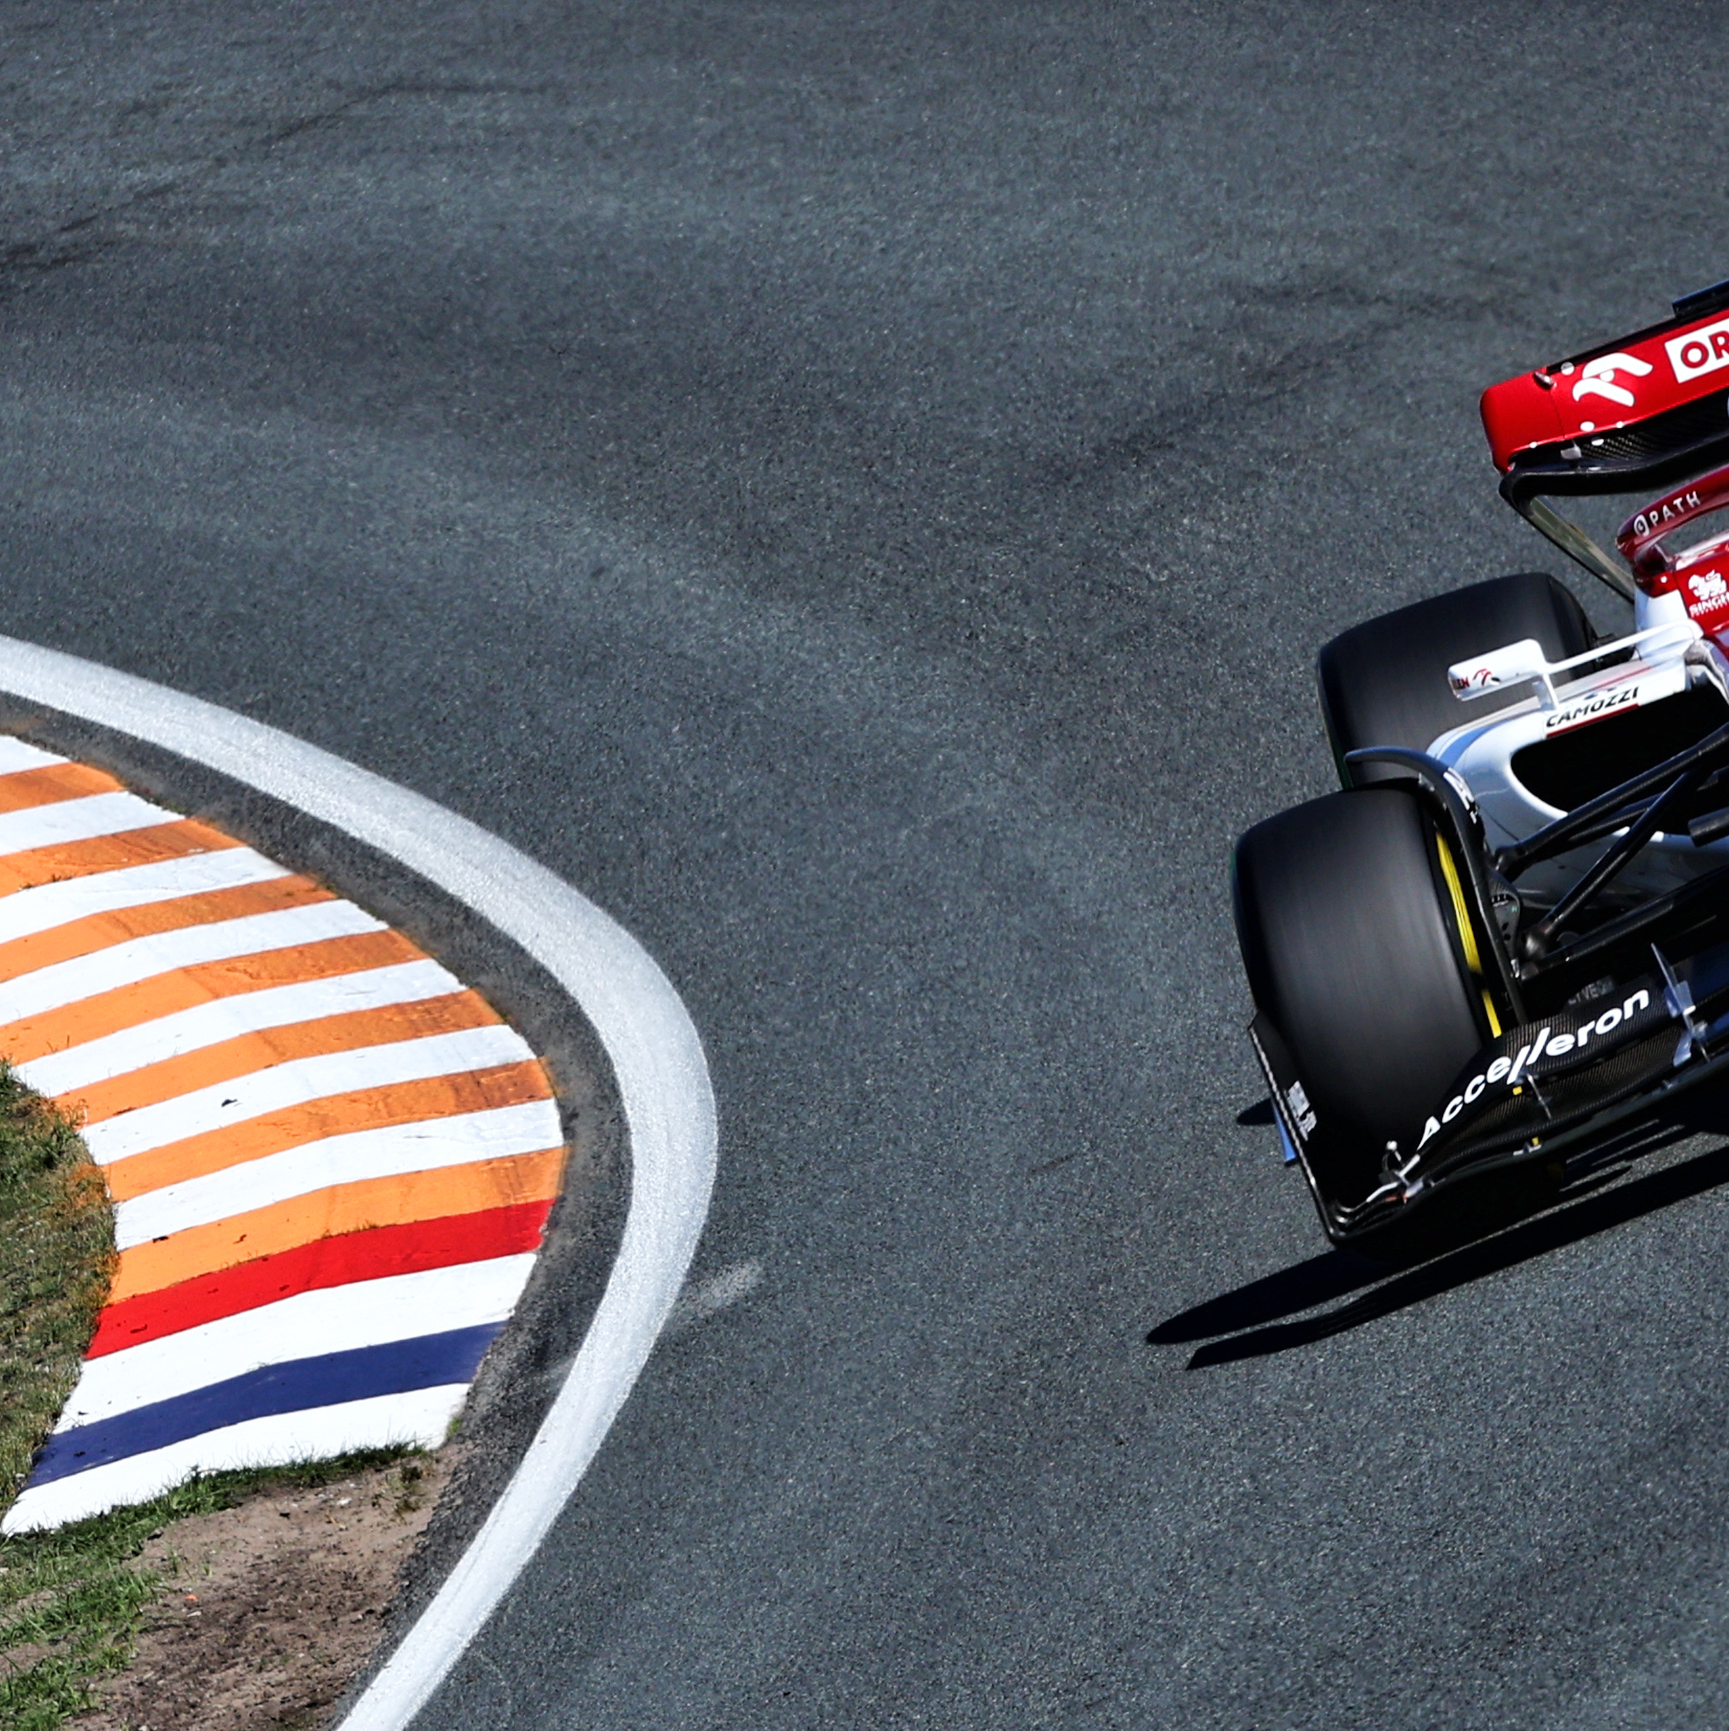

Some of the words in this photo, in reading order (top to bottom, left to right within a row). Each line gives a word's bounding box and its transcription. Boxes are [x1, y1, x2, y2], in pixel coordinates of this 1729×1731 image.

[1650, 490, 1701, 525] PATH
[1546, 686, 1640, 728] CAMOZZI
[1416, 988, 1650, 1152] Accelleron
